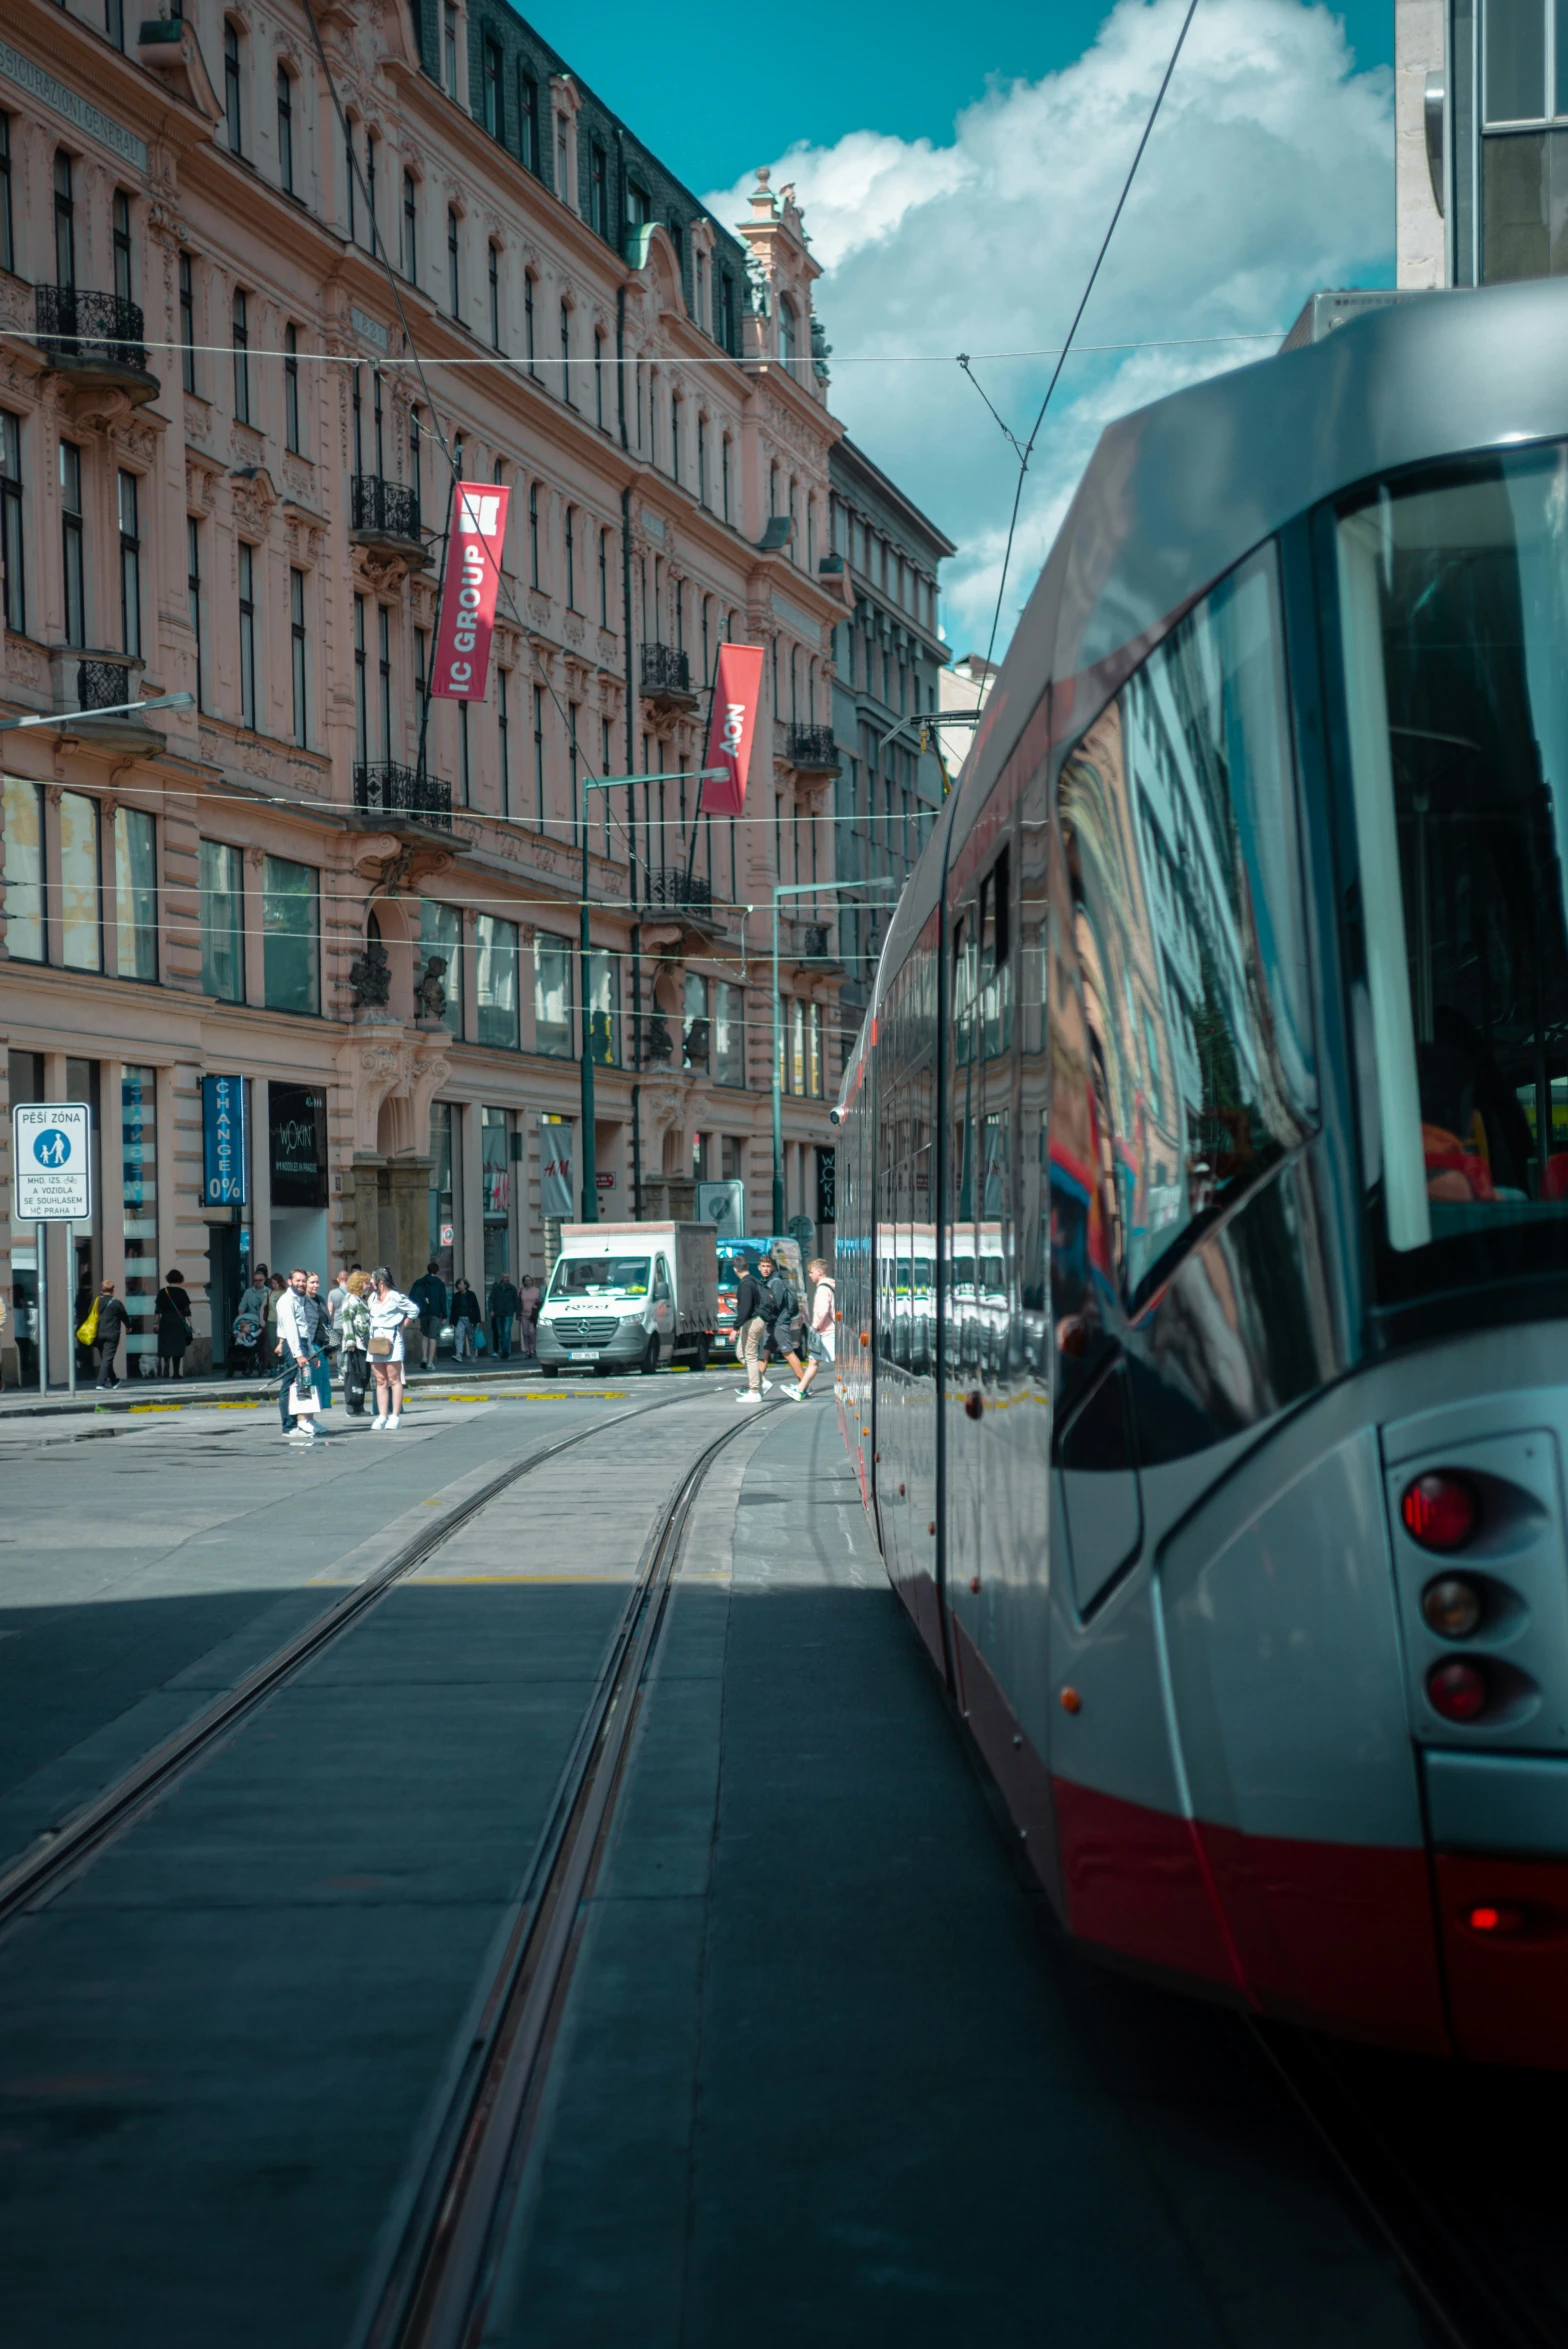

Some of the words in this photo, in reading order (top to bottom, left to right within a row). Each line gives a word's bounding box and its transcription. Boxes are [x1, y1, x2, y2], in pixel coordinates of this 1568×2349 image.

[85, 106, 140, 163] GENERALI
[454, 545, 485, 653] GROUP
[449, 661, 472, 692] IC
[719, 703, 746, 758] AON
[22, 1111, 47, 1124] PĚŠÍ
[51, 1111, 81, 1123] ZÓNA
[216, 1082, 232, 1172] CHANGE
[24, 1197, 33, 1205] SE
[209, 1177, 240, 1198] 0%
